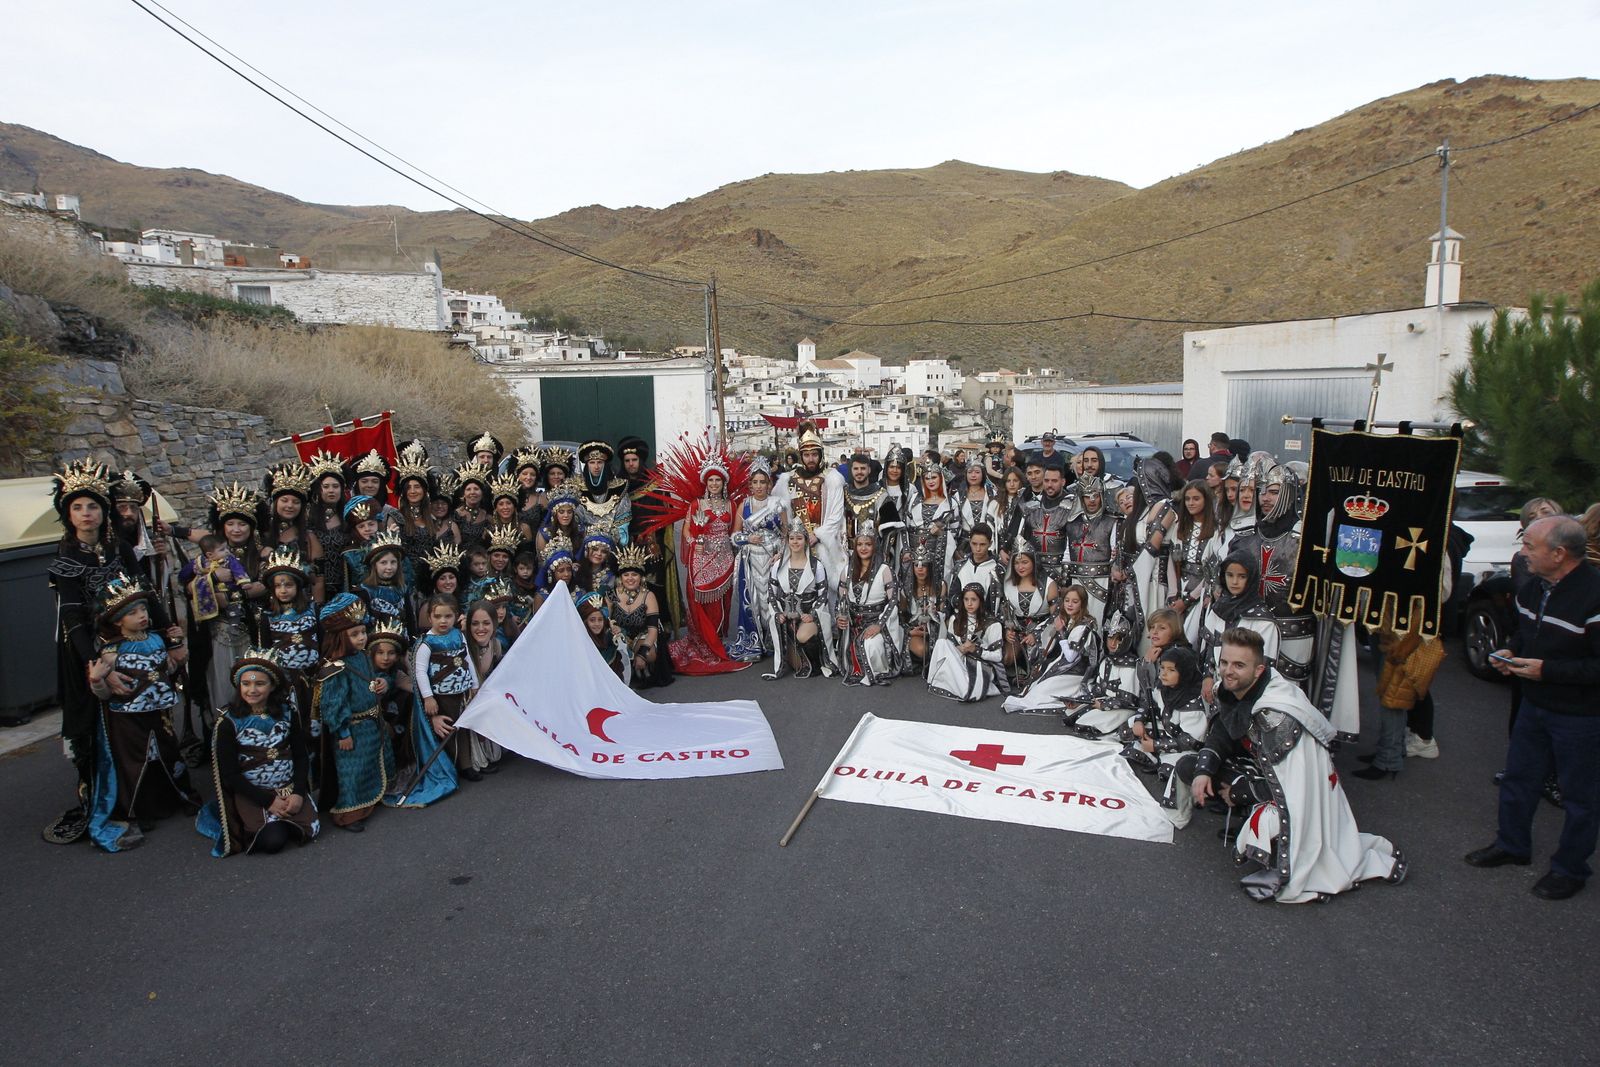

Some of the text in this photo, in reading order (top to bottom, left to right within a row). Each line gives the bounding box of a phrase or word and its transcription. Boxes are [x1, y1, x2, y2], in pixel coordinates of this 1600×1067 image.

[1358, 468, 1373, 485] DE
[1377, 470, 1425, 491] CASTRO
[505, 692, 750, 764] ULA DE CASTRO
[833, 765, 1126, 810] OLULA DE CASTRO
